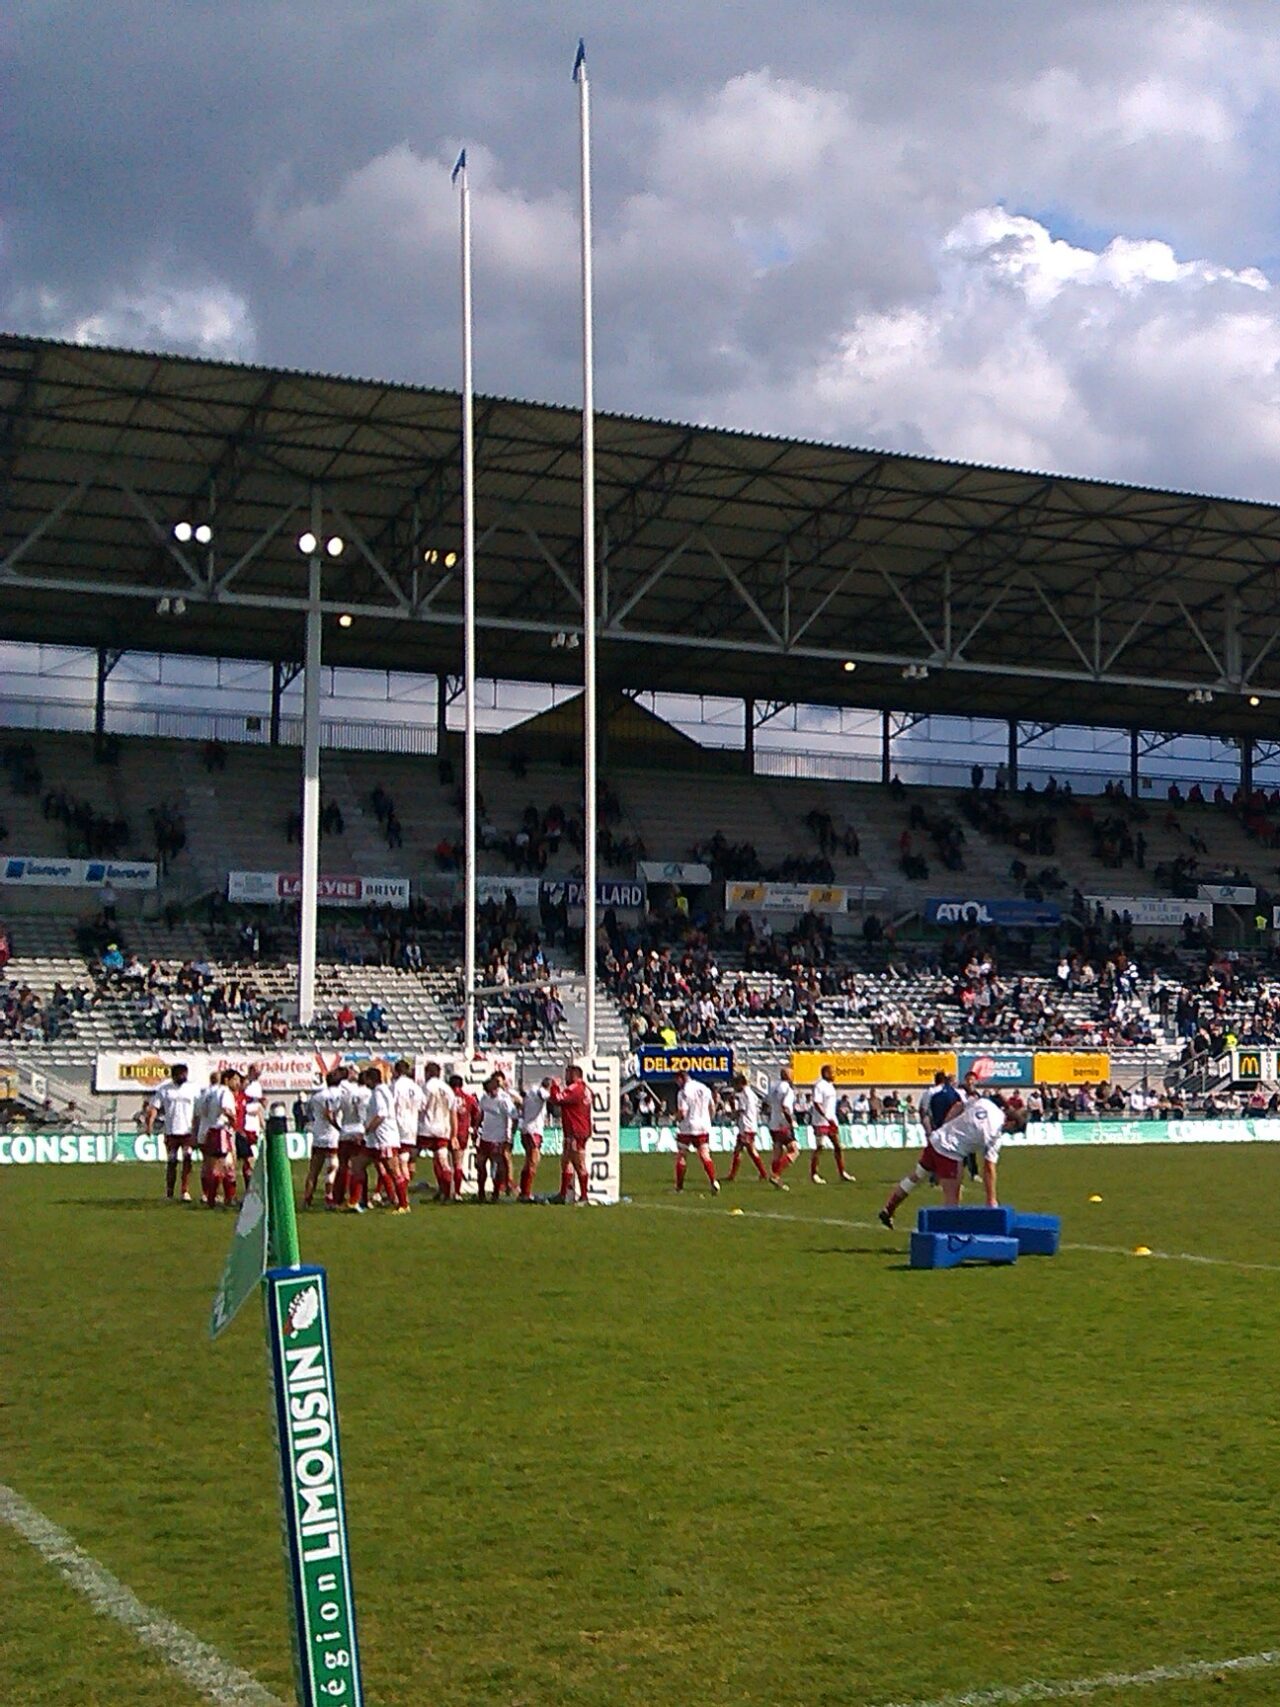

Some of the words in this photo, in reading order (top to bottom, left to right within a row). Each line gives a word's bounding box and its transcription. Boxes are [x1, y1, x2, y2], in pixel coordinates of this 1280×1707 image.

[283, 878, 357, 896] LAYRE
[365, 884, 406, 897] BRIVE
[643, 1056, 729, 1072] DELZONGLE
[286, 1345, 341, 1563] LIMOUSIN
[316, 1573, 350, 1707] égion
